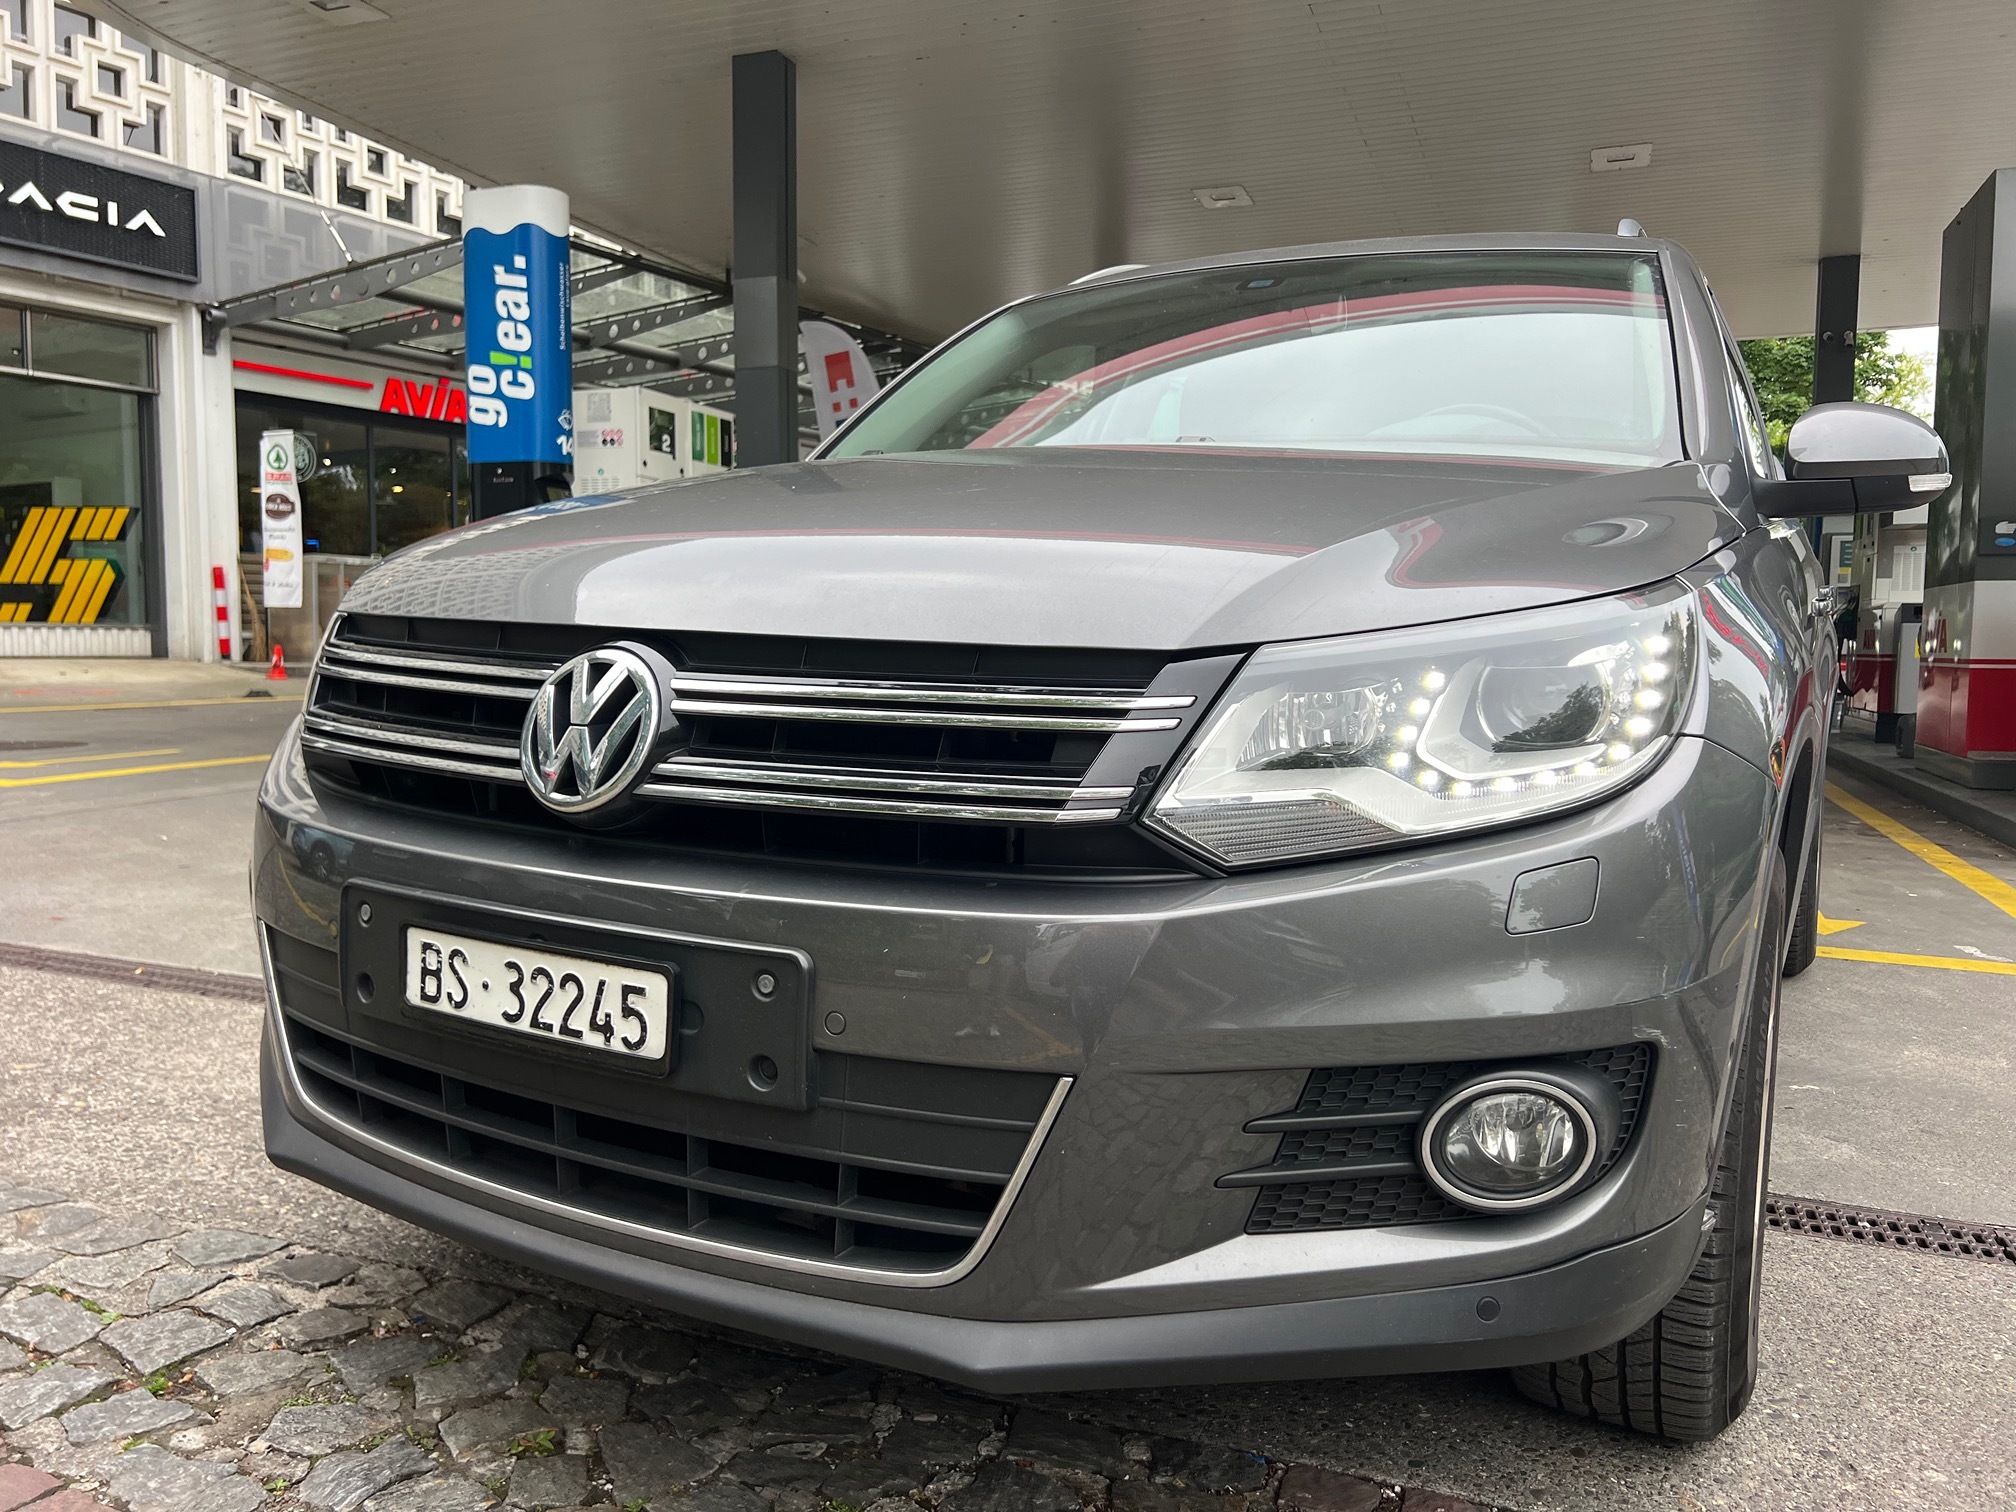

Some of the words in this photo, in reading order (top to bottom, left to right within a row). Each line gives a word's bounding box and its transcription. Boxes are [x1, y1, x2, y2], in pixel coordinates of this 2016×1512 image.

[0, 181, 167, 238] ACIA
[468, 363, 508, 428] go
[662, 433, 671, 452] 2
